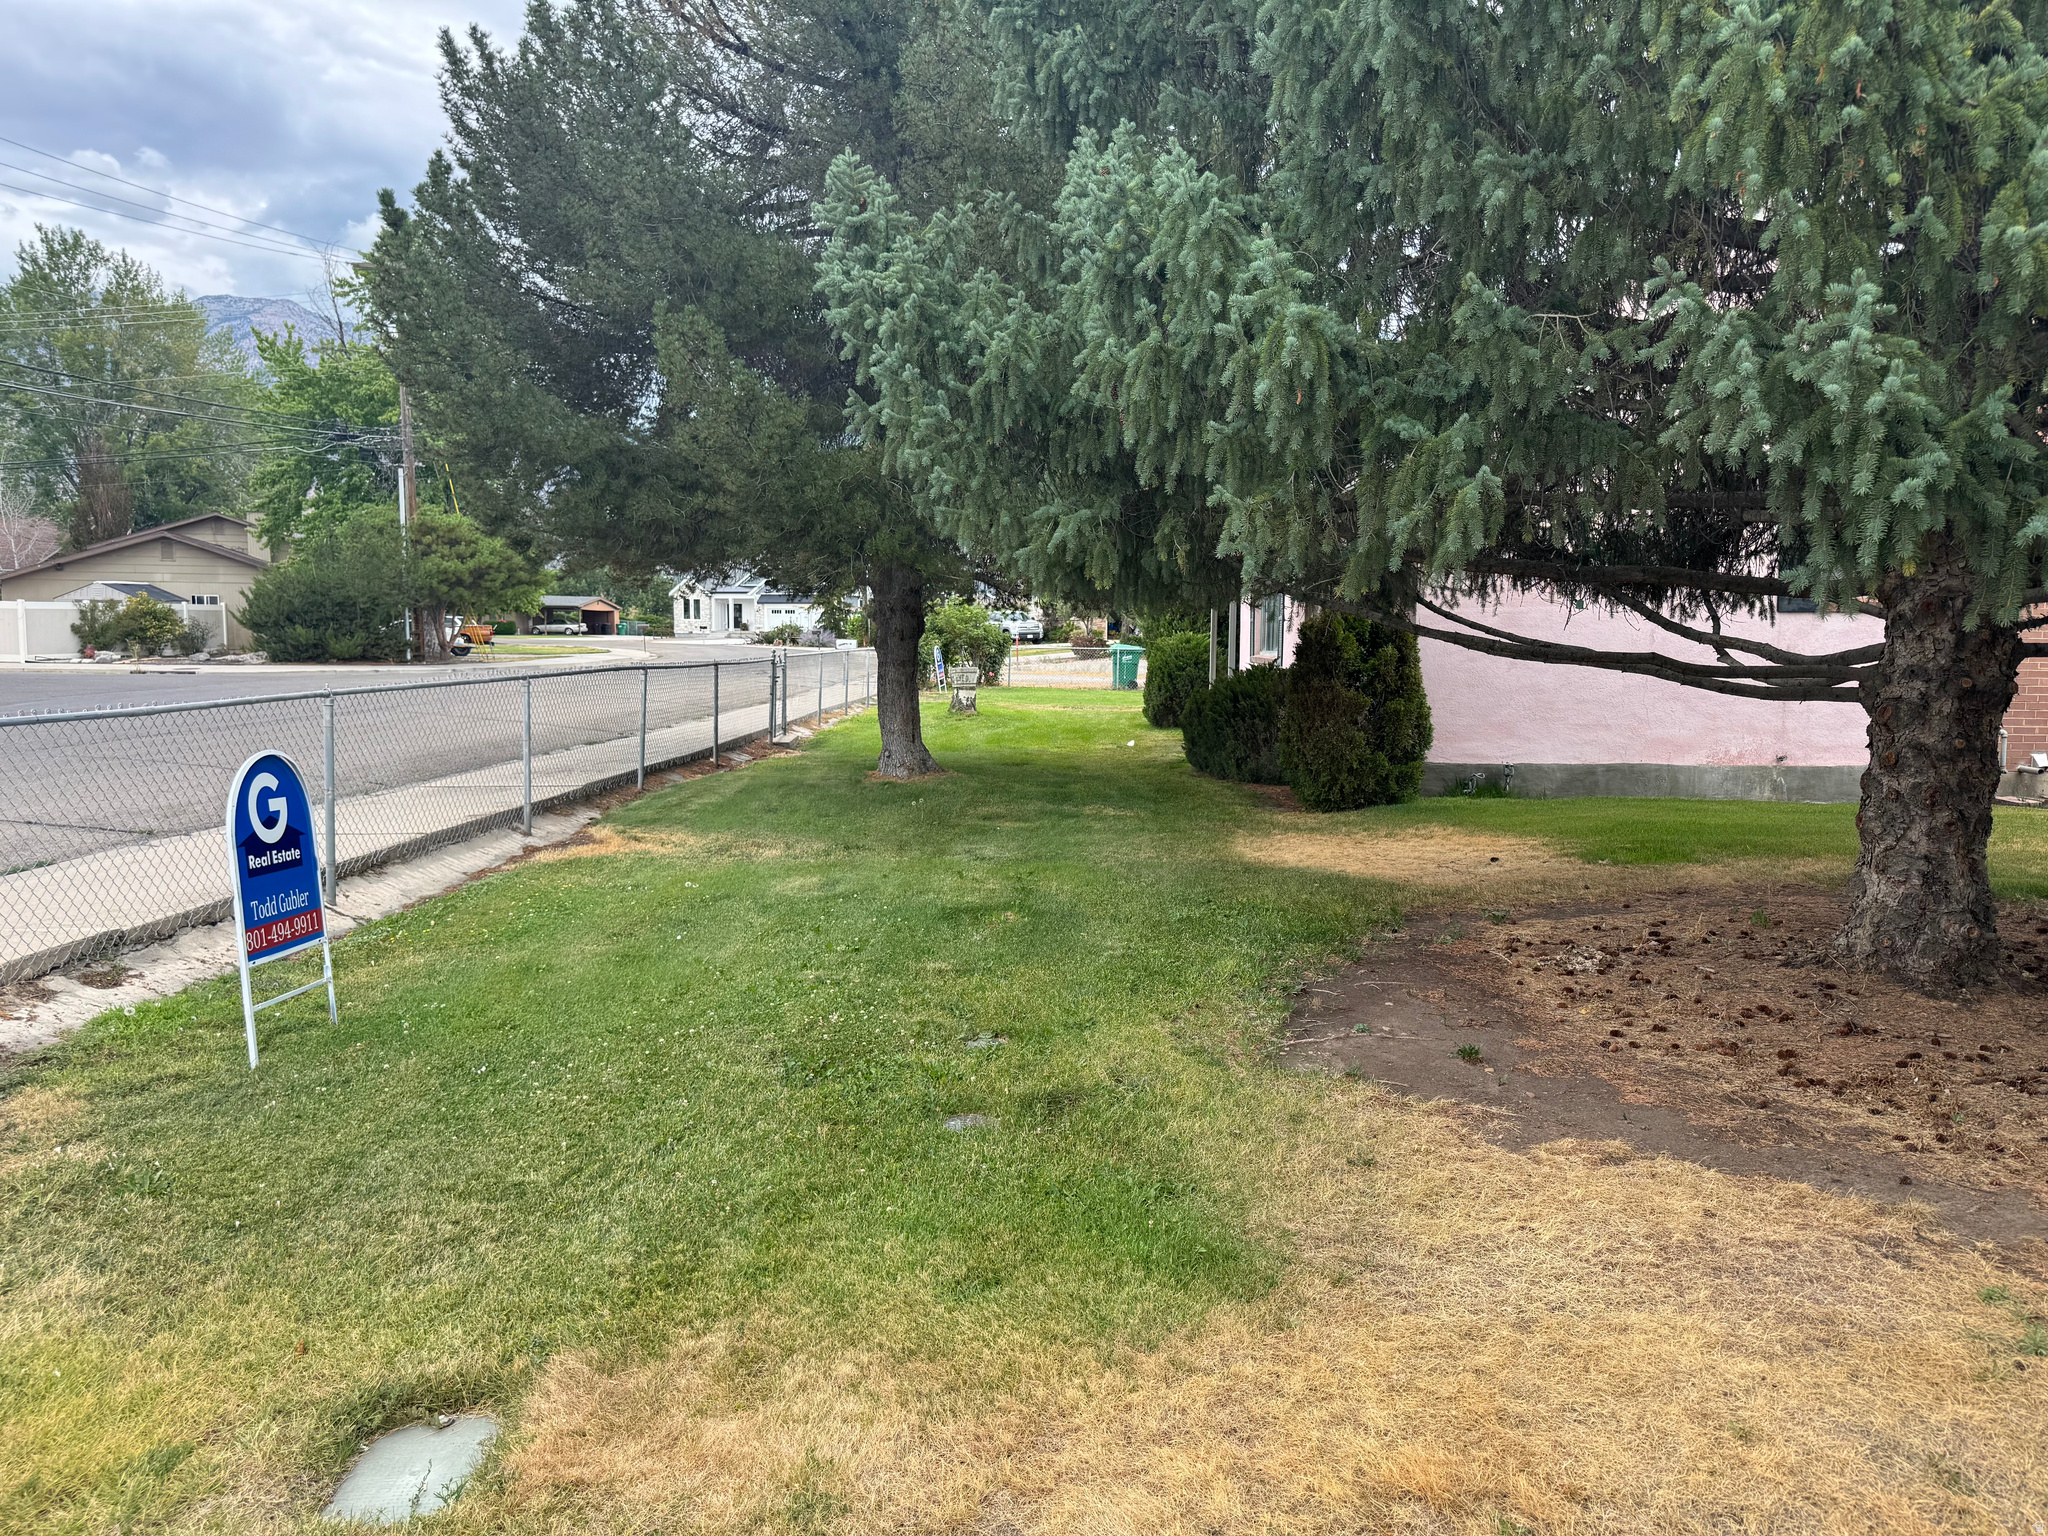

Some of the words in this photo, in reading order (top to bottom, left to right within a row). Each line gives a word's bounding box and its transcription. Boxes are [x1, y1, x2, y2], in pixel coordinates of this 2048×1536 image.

[248, 772, 288, 844] G
[248, 851, 271, 869] Real
[272, 847, 301, 864] Estate
[250, 895, 278, 921] Todd
[278, 889, 309, 913] Gubler
[246, 912, 319, 952] 801-494-9911
